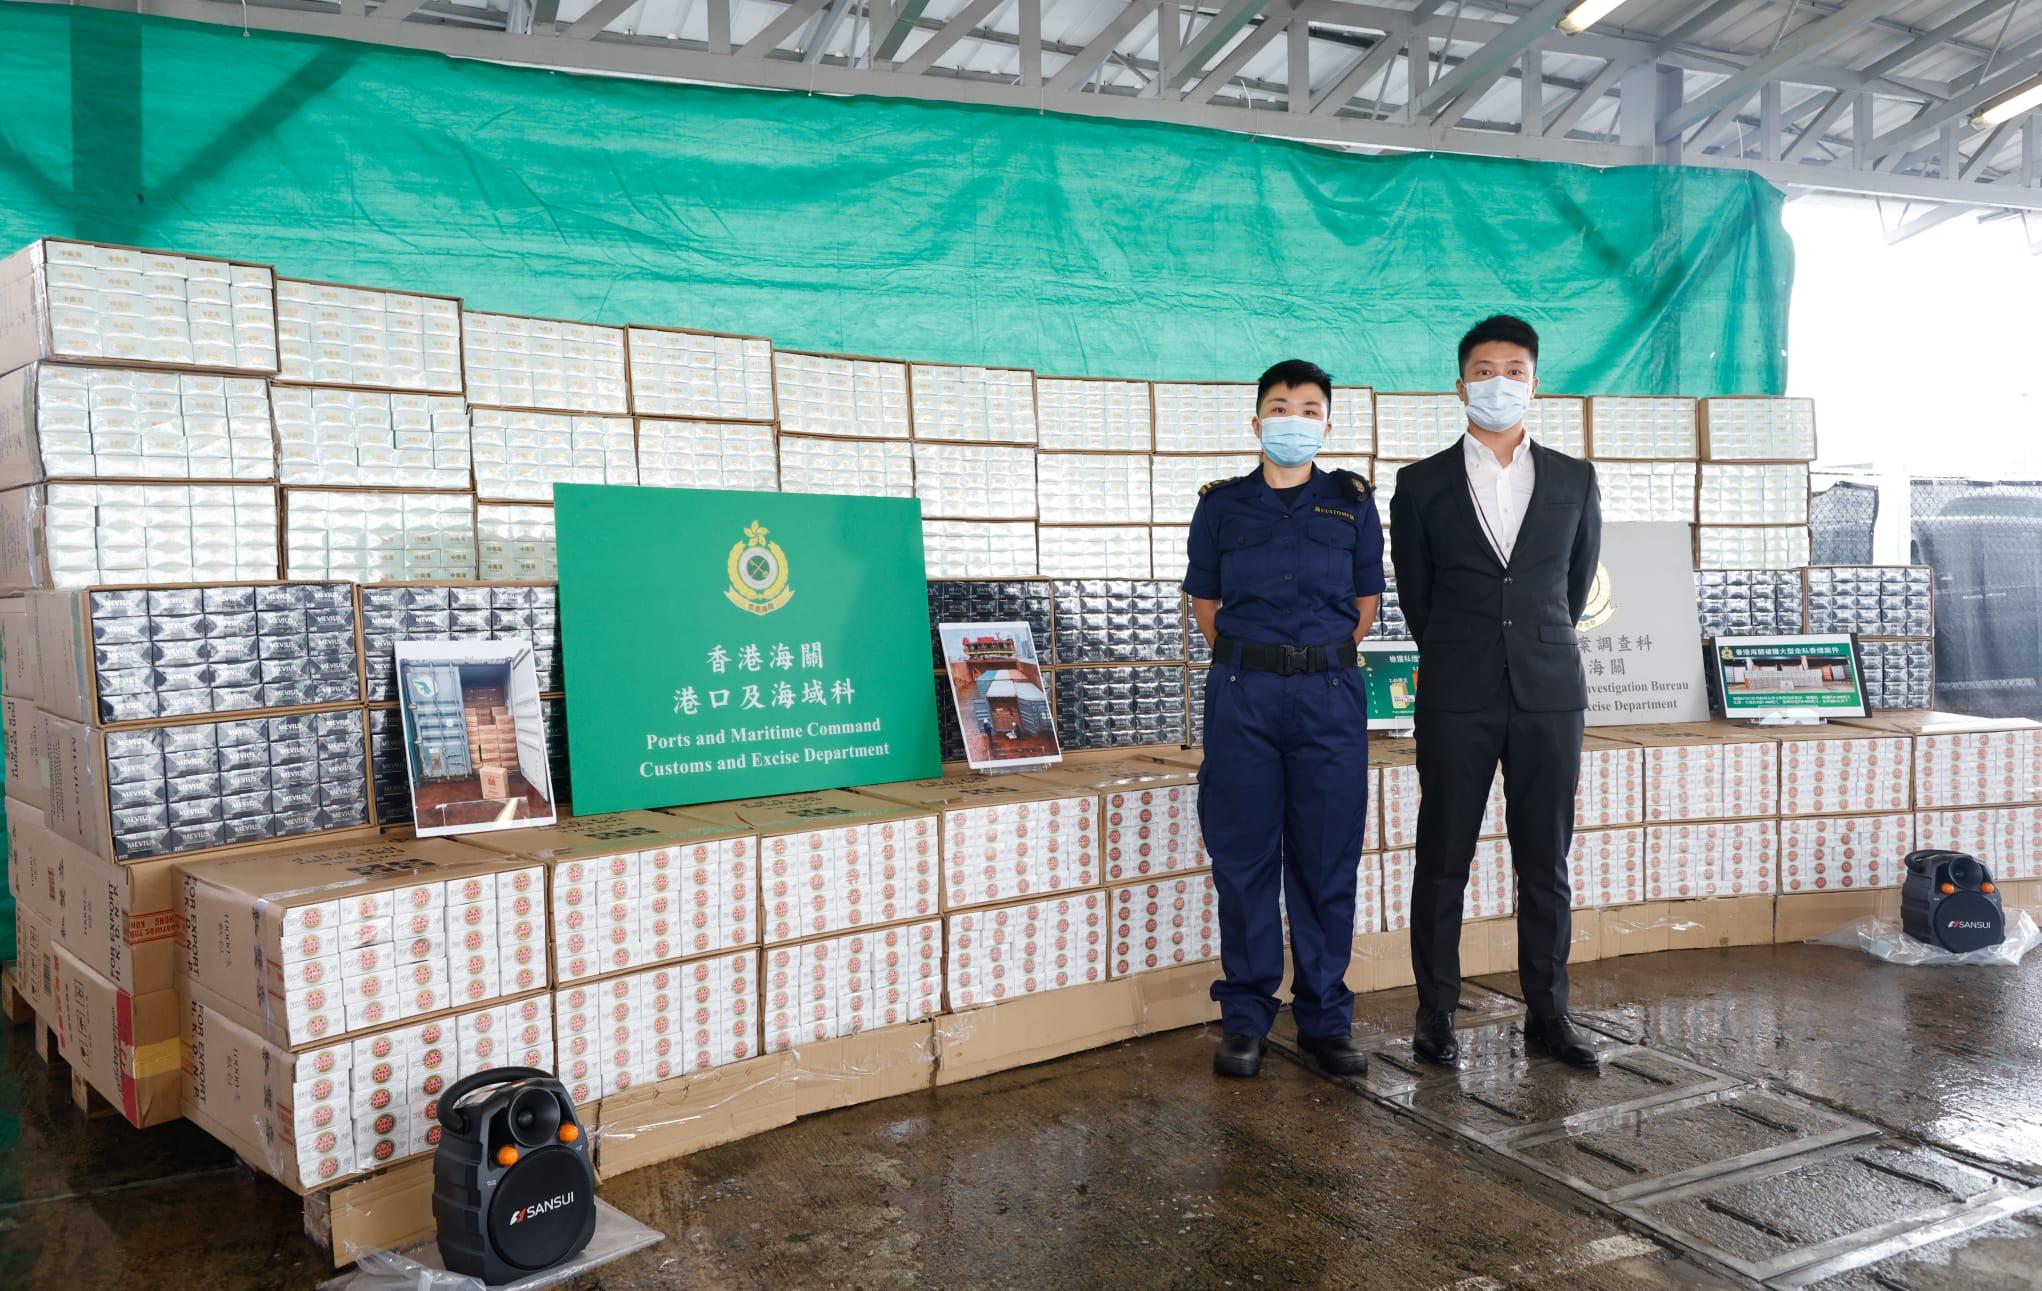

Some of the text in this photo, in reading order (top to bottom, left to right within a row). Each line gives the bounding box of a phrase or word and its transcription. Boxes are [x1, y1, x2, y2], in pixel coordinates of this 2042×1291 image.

[706, 642, 824, 674] 香港海關
[1651, 681, 1689, 691] Bureau
[673, 678, 855, 715] 港口及海域科
[1615, 699, 1677, 713] Department
[646, 718, 881, 749] Ports and Maritime Command
[176, 758, 204, 766] MEVIUS
[640, 742, 889, 777] Customs and Excise Department
[231, 776, 257, 784] MEVIUS
[179, 783, 206, 791] MEVIUS
[121, 790, 150, 798] MEVIUS
[179, 808, 207, 816] MEVIUS
[123, 816, 151, 824] MEVIUS
[235, 824, 261, 832] MEVIUS
[183, 832, 210, 840] MEVIUS
[128, 840, 156, 848] MEVIUS
[189, 877, 199, 976] FOR EXPORT
[527, 1192, 574, 1219] SANSUI
